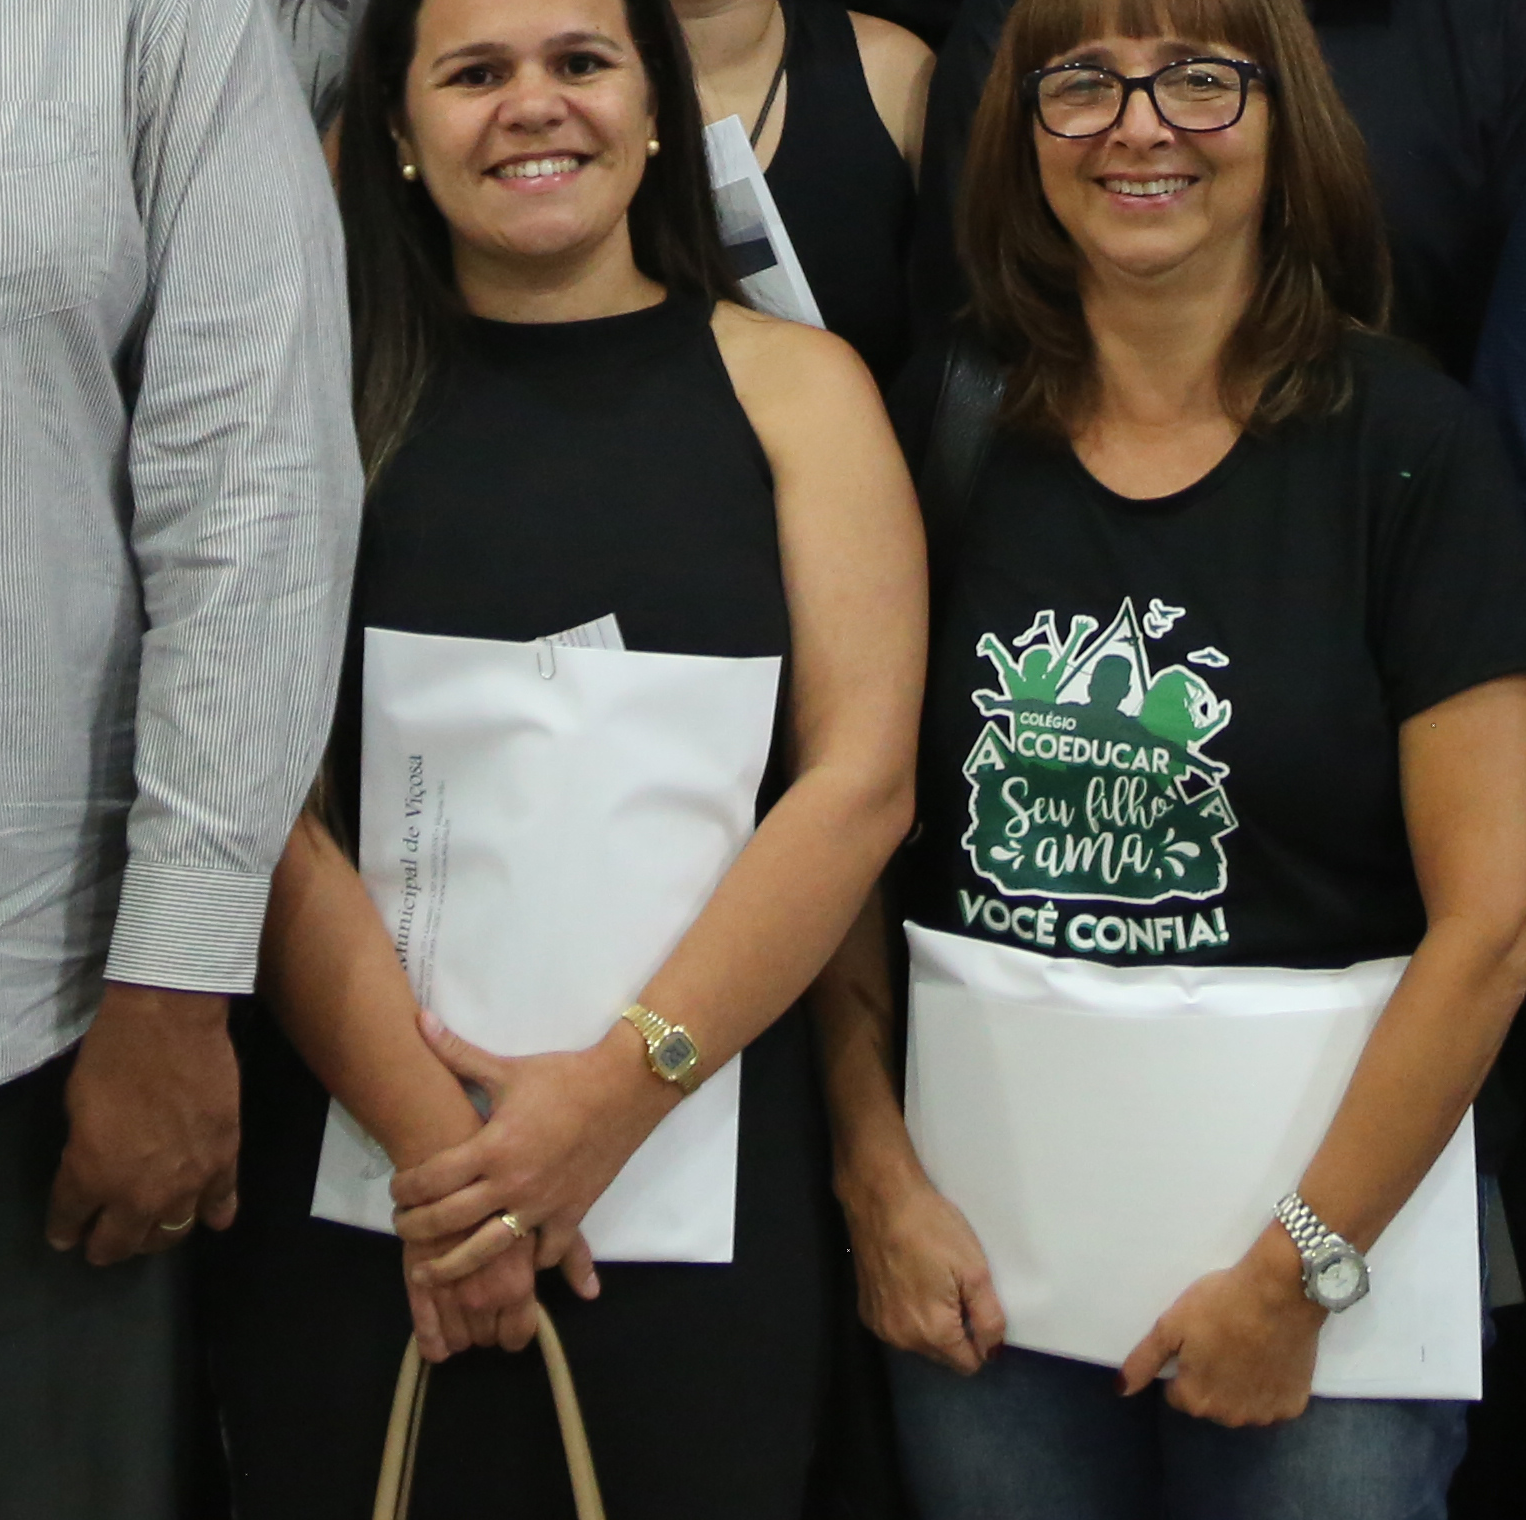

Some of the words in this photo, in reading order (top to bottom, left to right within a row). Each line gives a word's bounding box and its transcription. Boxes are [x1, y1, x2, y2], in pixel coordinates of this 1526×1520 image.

[1020, 710, 1077, 731] COLÉGIO
[1017, 730, 1171, 775] COEDUCAR
[405, 754, 426, 819] Viçosa
[1000, 776, 1075, 839] Seu
[1086, 776, 1175, 833] filho
[402, 826, 420, 853] de
[958, 889, 1058, 946] VOCÊ
[1067, 907, 1230, 953] CONFIA!
